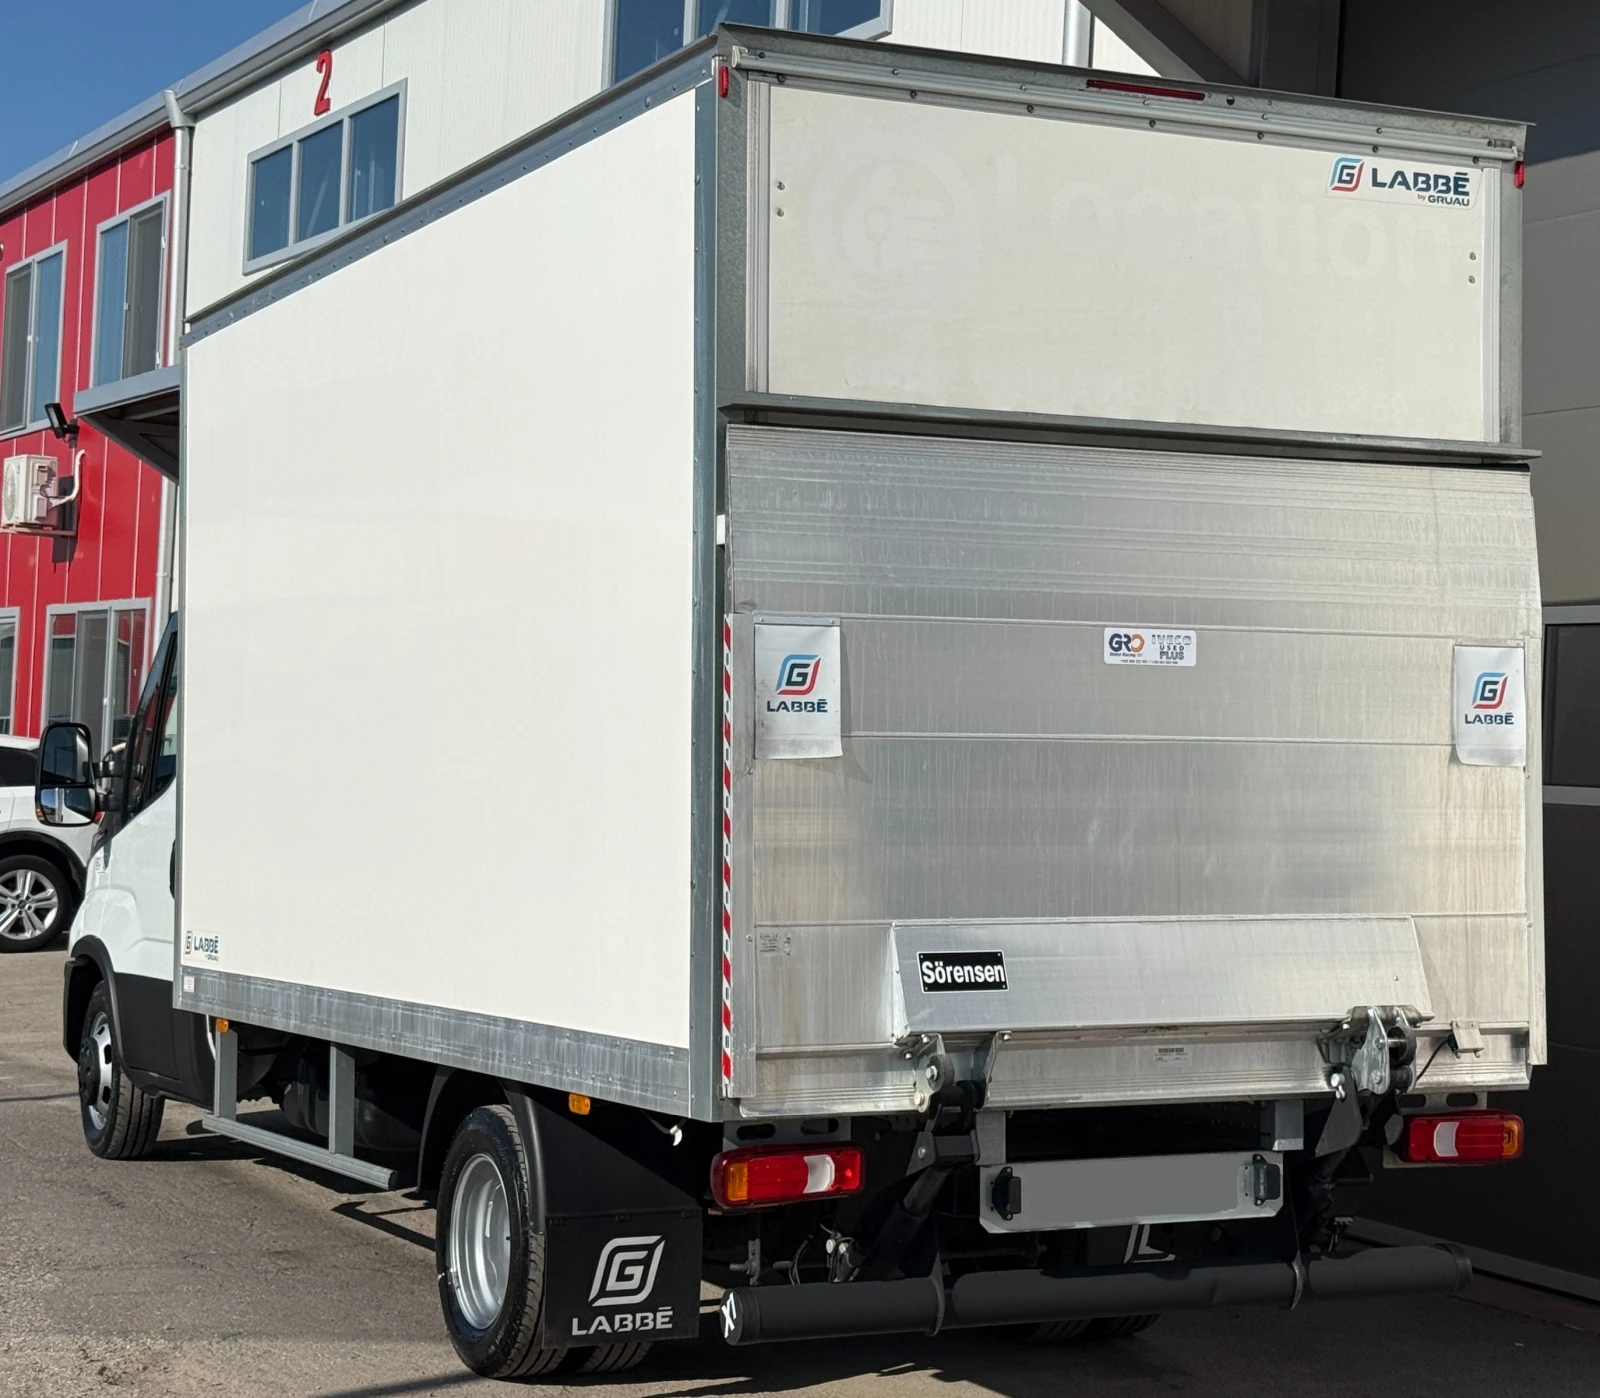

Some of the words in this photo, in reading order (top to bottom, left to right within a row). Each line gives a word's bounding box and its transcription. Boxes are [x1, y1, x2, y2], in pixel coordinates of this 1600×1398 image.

[314, 49, 333, 116] 2
[1428, 195, 1470, 207] GRUAU
[1108, 633, 1145, 653] GRO
[1151, 634, 1193, 646] IVECO
[1160, 651, 1185, 661] PLUS
[922, 961, 1006, 984] Sörensen
